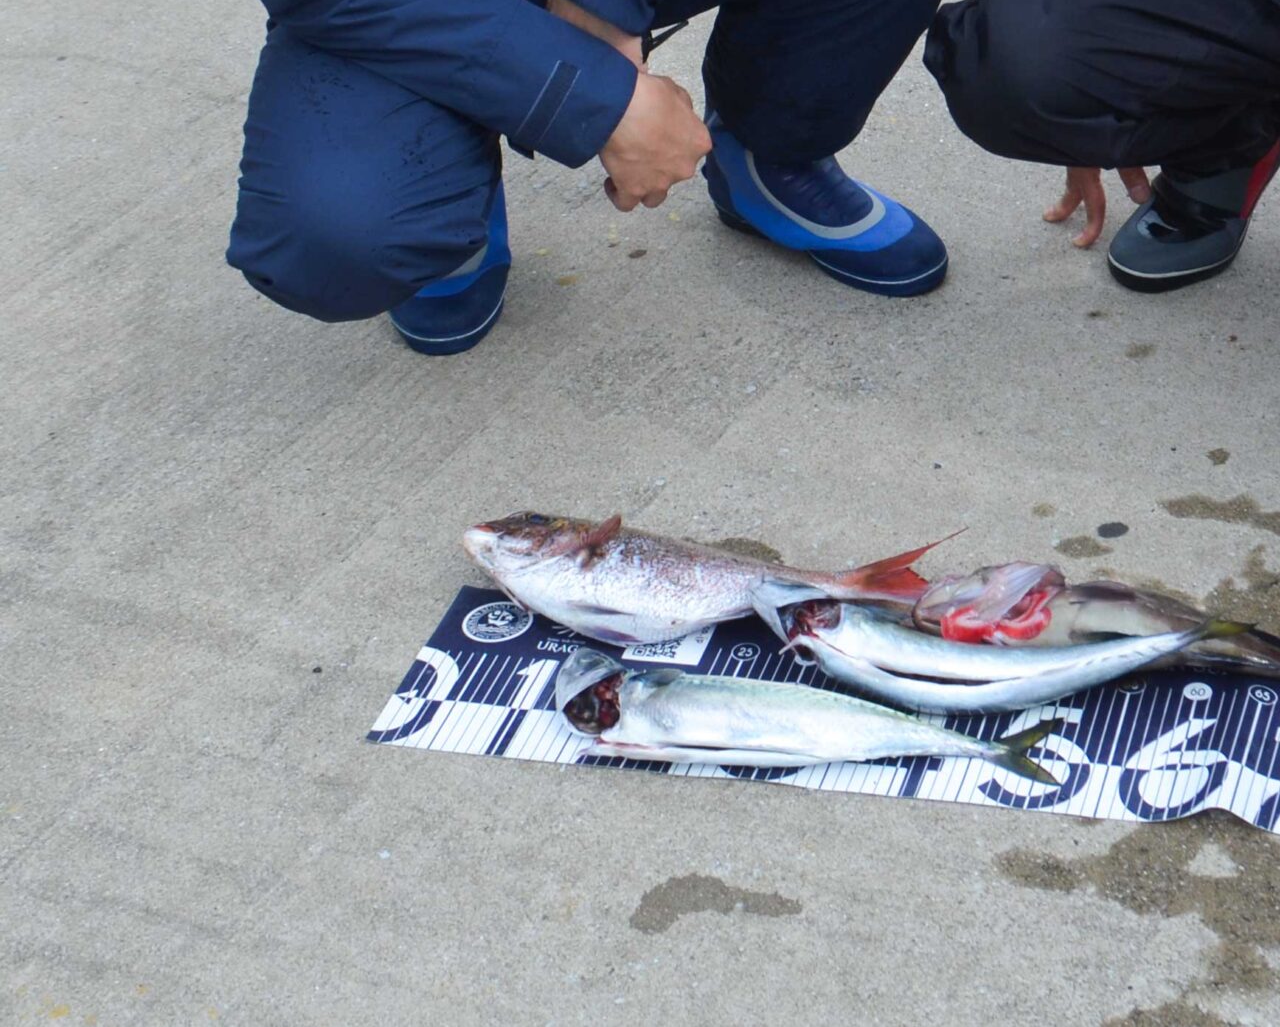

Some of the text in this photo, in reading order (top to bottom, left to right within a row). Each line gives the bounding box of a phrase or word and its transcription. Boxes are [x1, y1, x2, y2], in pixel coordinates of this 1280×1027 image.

[537, 640, 579, 654] URAG
[1254, 689, 1271, 702] 65
[485, 659, 560, 757] 1
[1119, 718, 1231, 822] 6
